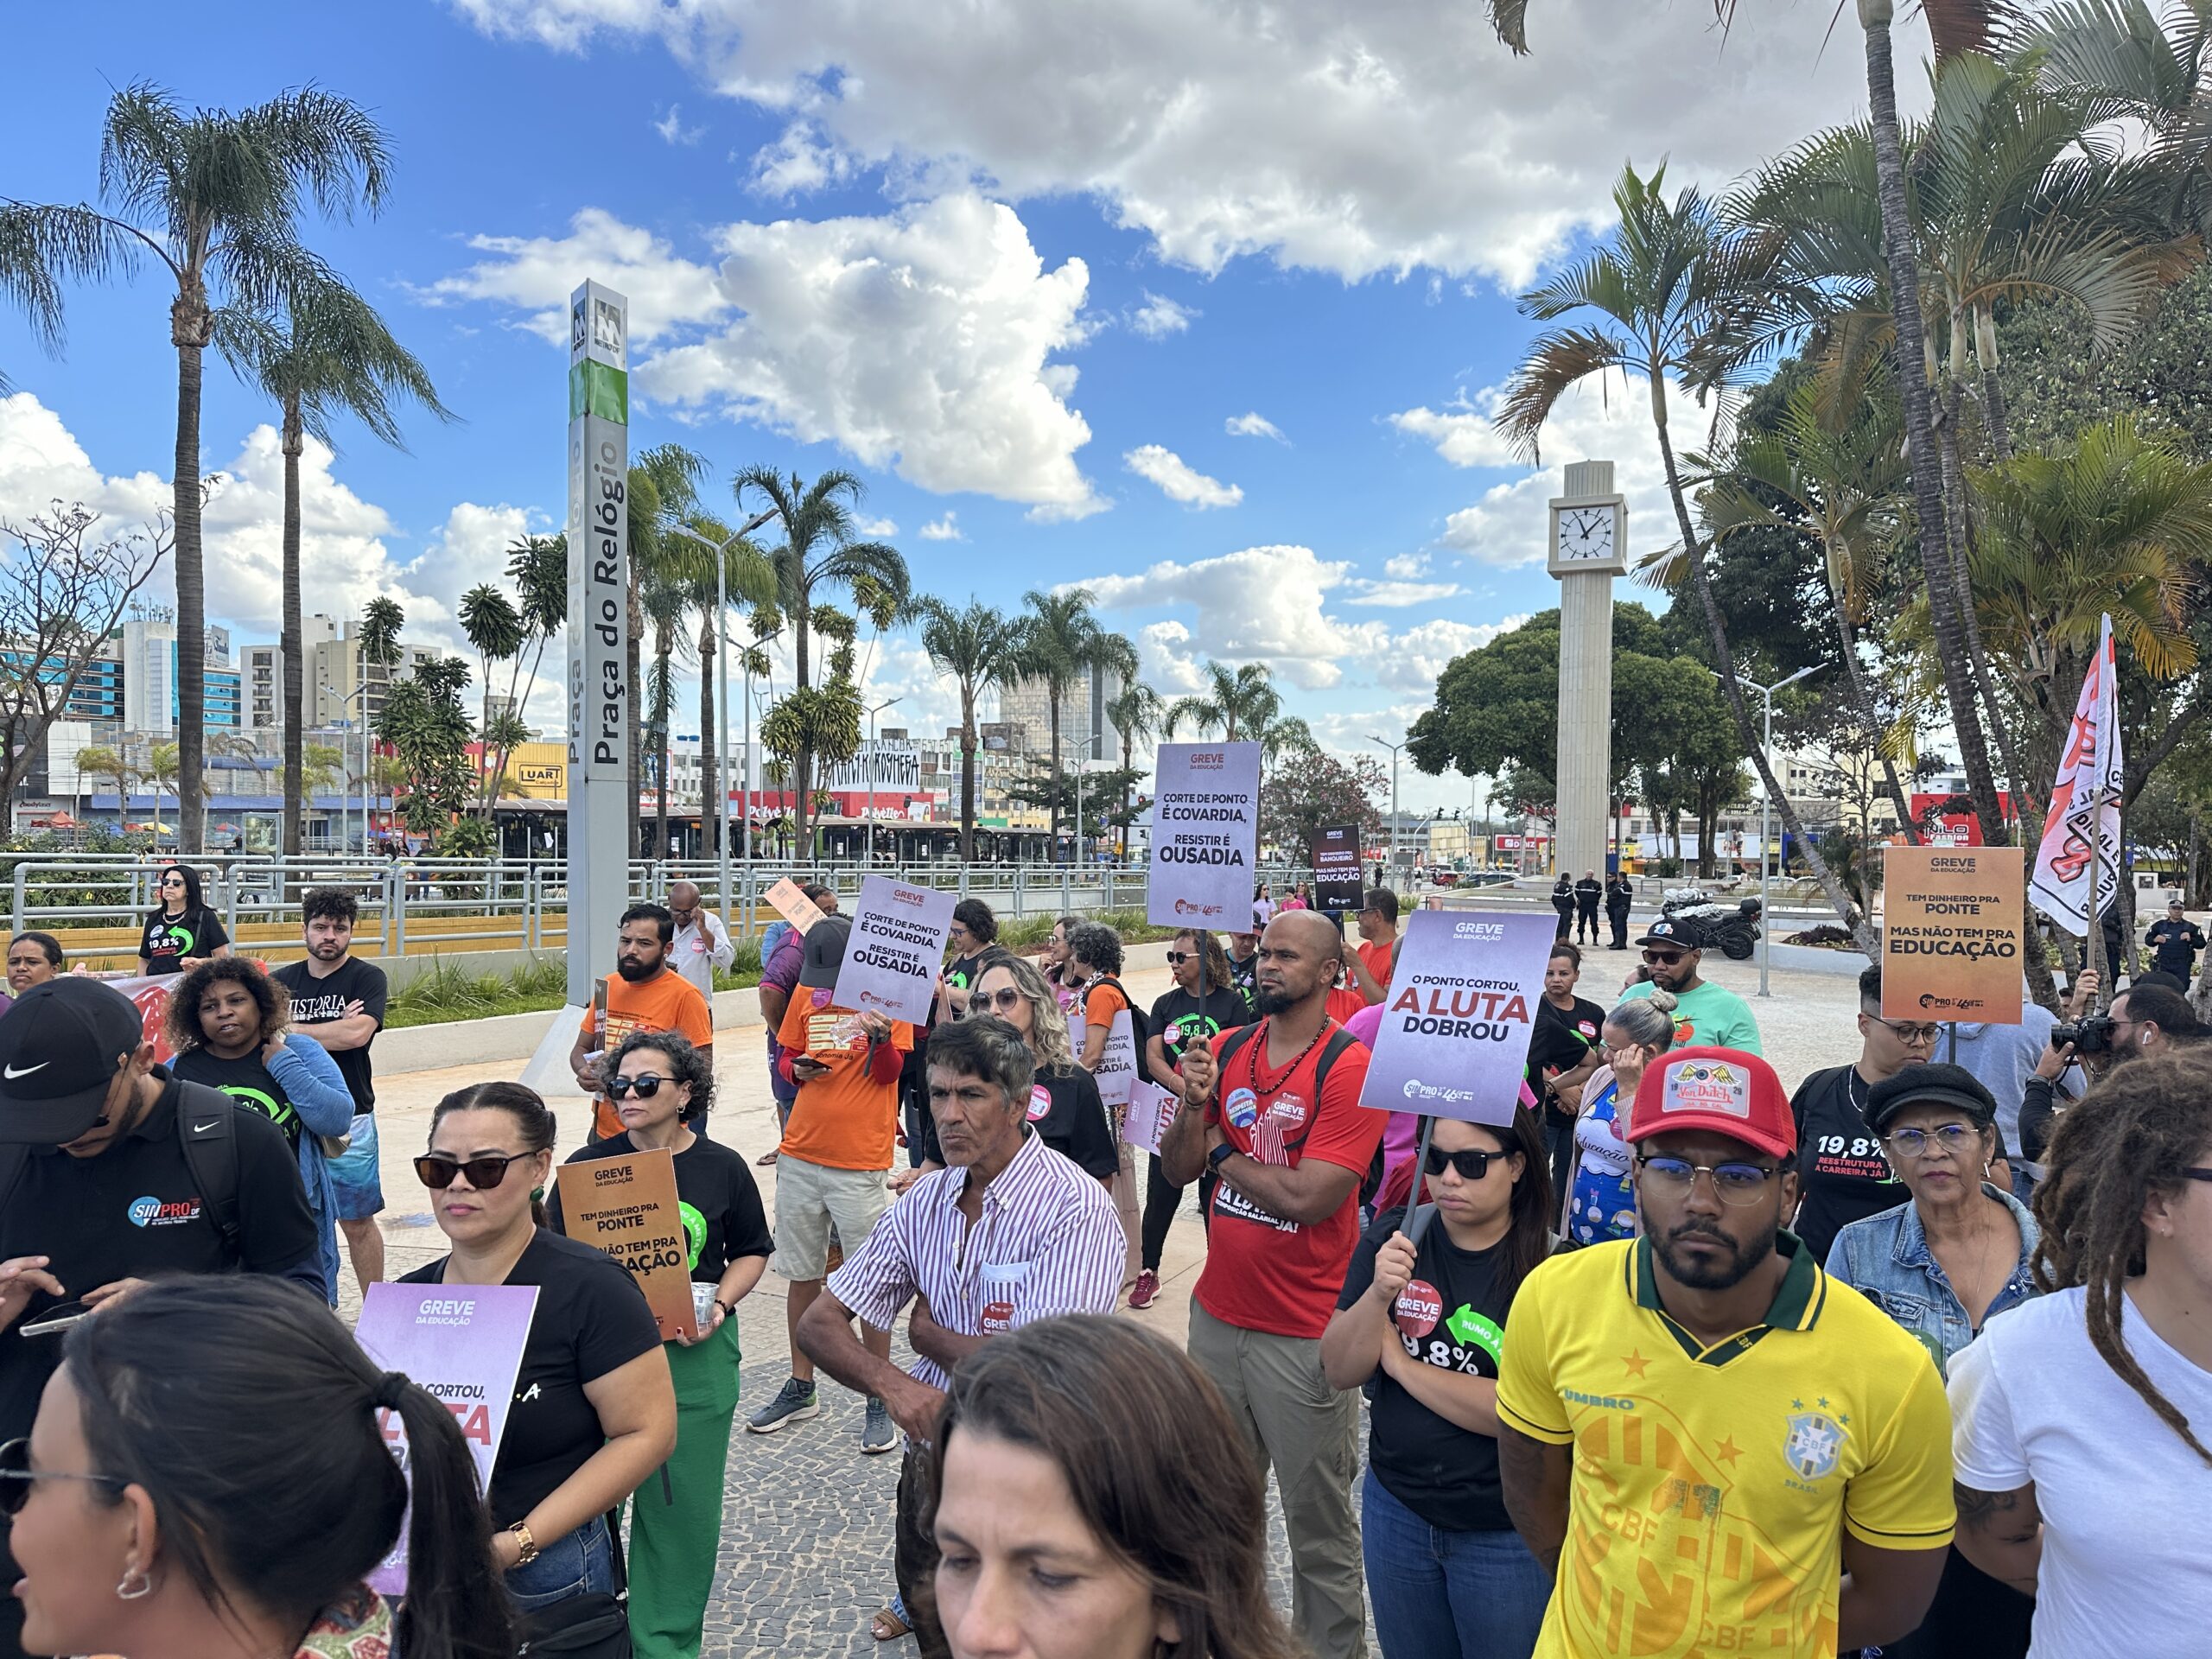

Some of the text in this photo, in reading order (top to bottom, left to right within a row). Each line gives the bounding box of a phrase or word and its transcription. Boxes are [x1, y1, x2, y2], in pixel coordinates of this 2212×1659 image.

[594, 441, 625, 764] Praça do Relógio
[569, 659, 583, 764] Praça
[1190, 753, 1224, 764] GREVE
[521, 768, 560, 781] LUART
[1163, 793, 1248, 804] CORTE DE PONTO
[1162, 804, 1247, 823] É COVARDIA,
[1174, 834, 1230, 846] RESISTIR É
[1160, 846, 1244, 866] OUSADIA
[1930, 857, 1976, 868] GREVE
[1316, 872, 1360, 883] EDUCAÇÃO
[894, 889, 925, 903] GREVE
[1925, 904, 1980, 915] PONTE
[864, 912, 940, 936] CORTE DE PONTO
[1455, 922, 1504, 935] GREVE
[1891, 925, 2015, 939] MAS NÃO TEM PRA
[861, 919, 937, 950] É COVARDIA,
[149, 937, 179, 949] 19,8%
[1890, 938, 2015, 961] EDUCAÇÃO
[869, 944, 919, 963] RESISTIR É
[853, 950, 928, 979] OUSADIA
[1412, 975, 1520, 993] O PONTO CORTOU,
[1390, 987, 1529, 1024] A LUTA
[1402, 1016, 1509, 1042] DOBROU
[1672, 1039, 1686, 1049] ball
[1092, 1062, 1132, 1075] SADIA
[1671, 1083, 1743, 1103] 19 Von Dutch 29
[1274, 1101, 1305, 1116] GREVE
[1278, 1110, 1304, 1122] EDUCAÇÃO
[1818, 1135, 1886, 1159] 19,8%
[1818, 1156, 1883, 1169] REESTRUTURA
[594, 1166, 633, 1181] GREVE
[1822, 1165, 1867, 1176] CARREIRA
[1869, 1167, 1885, 1178] JÁ!
[603, 1176, 633, 1186] EDUCAÇÃO
[1217, 1185, 1231, 1203] NA
[133, 1202, 190, 1218] SINPRO
[580, 1202, 659, 1222] TEM DINHEIRO PRA
[1248, 1211, 1280, 1225] SALARIAL
[596, 1215, 645, 1232] PONTE
[600, 1236, 677, 1255] NÃO TEM PRA
[619, 1250, 681, 1276] AÇÃO
[418, 1300, 476, 1316] GREVE
[1397, 1297, 1440, 1315] GREVE
[415, 1316, 471, 1327] DA EDUCAÇÃO
[983, 1318, 1009, 1330] GRE
[1404, 1311, 1437, 1322] EDUCAÇÃO
[1462, 1319, 1492, 1340] RUMO
[1395, 1325, 1479, 1376] 9,8%
[425, 1383, 486, 1400] CORTOU,
[1563, 1389, 1635, 1410] UMBRO
[1802, 1438, 1827, 1451] CBF
[1600, 1502, 1658, 1548] CBF
